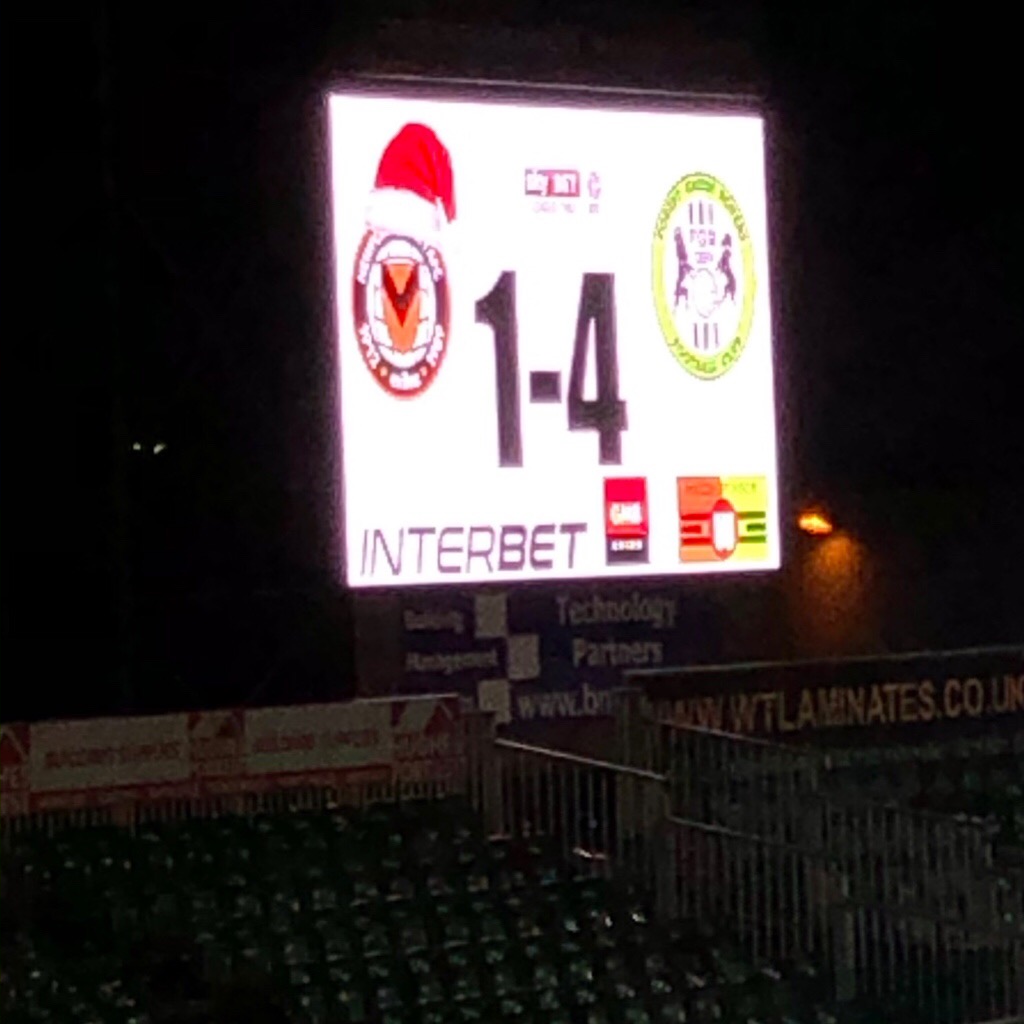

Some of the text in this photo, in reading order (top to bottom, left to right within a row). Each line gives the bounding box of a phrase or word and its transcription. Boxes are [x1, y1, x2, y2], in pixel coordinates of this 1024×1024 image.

[359, 522, 589, 577] INTERBET
[555, 590, 676, 629] Technology
[572, 636, 664, 668] Partners
